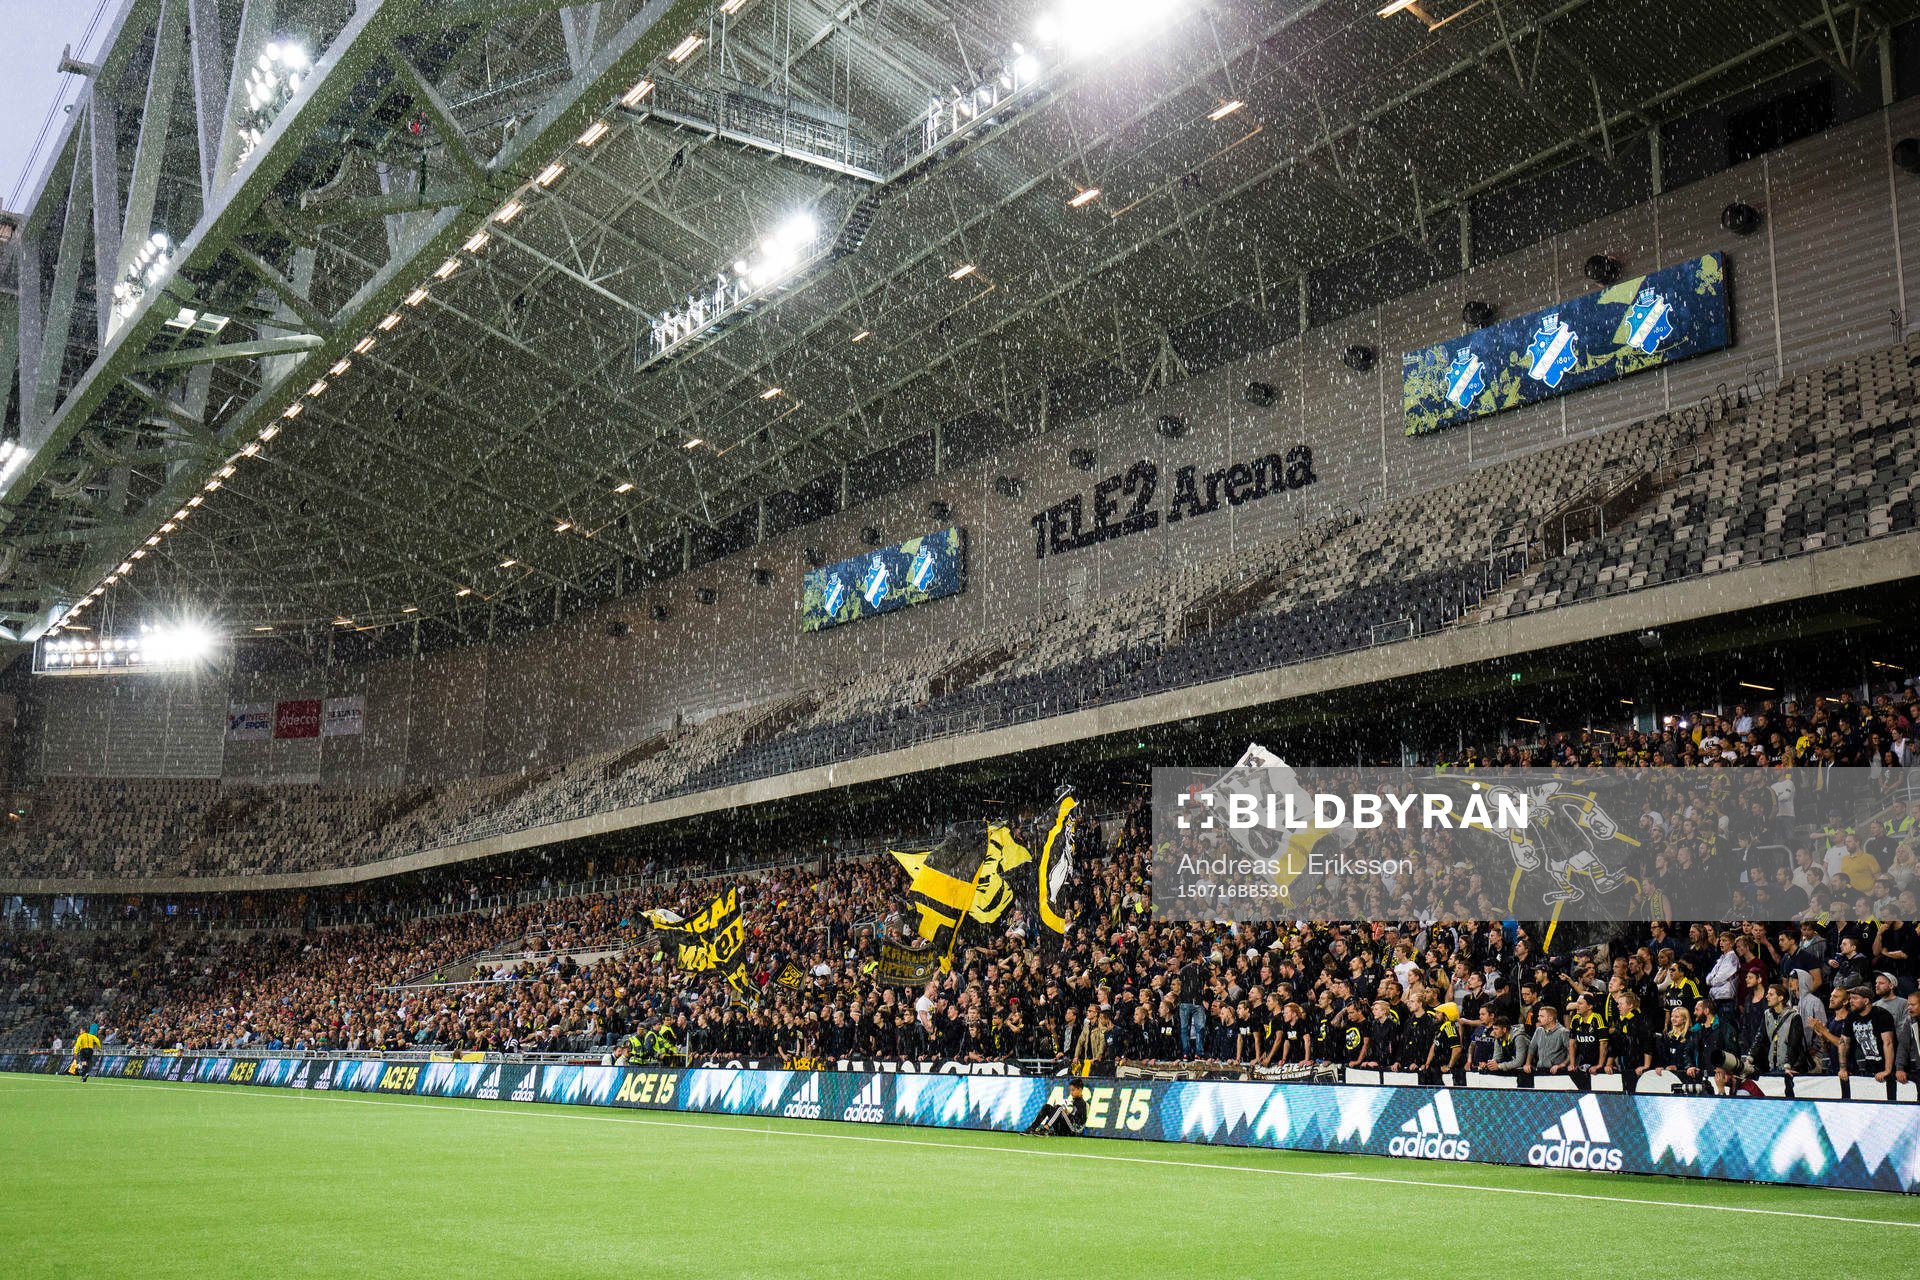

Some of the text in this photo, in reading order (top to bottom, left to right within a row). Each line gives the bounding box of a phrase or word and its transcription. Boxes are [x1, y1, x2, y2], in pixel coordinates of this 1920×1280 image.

[1031, 445, 1317, 560] TELE2 Arena
[228, 1062, 249, 1080] ACE
[379, 1066, 420, 1090] ACE 15
[616, 1073, 678, 1105] ACE 15
[784, 1100, 821, 1119] adidas
[844, 1104, 884, 1123] adidas
[1115, 1088, 1152, 1131] 15
[1388, 1132, 1471, 1161] adidas
[1528, 1139, 1624, 1171] adidas
